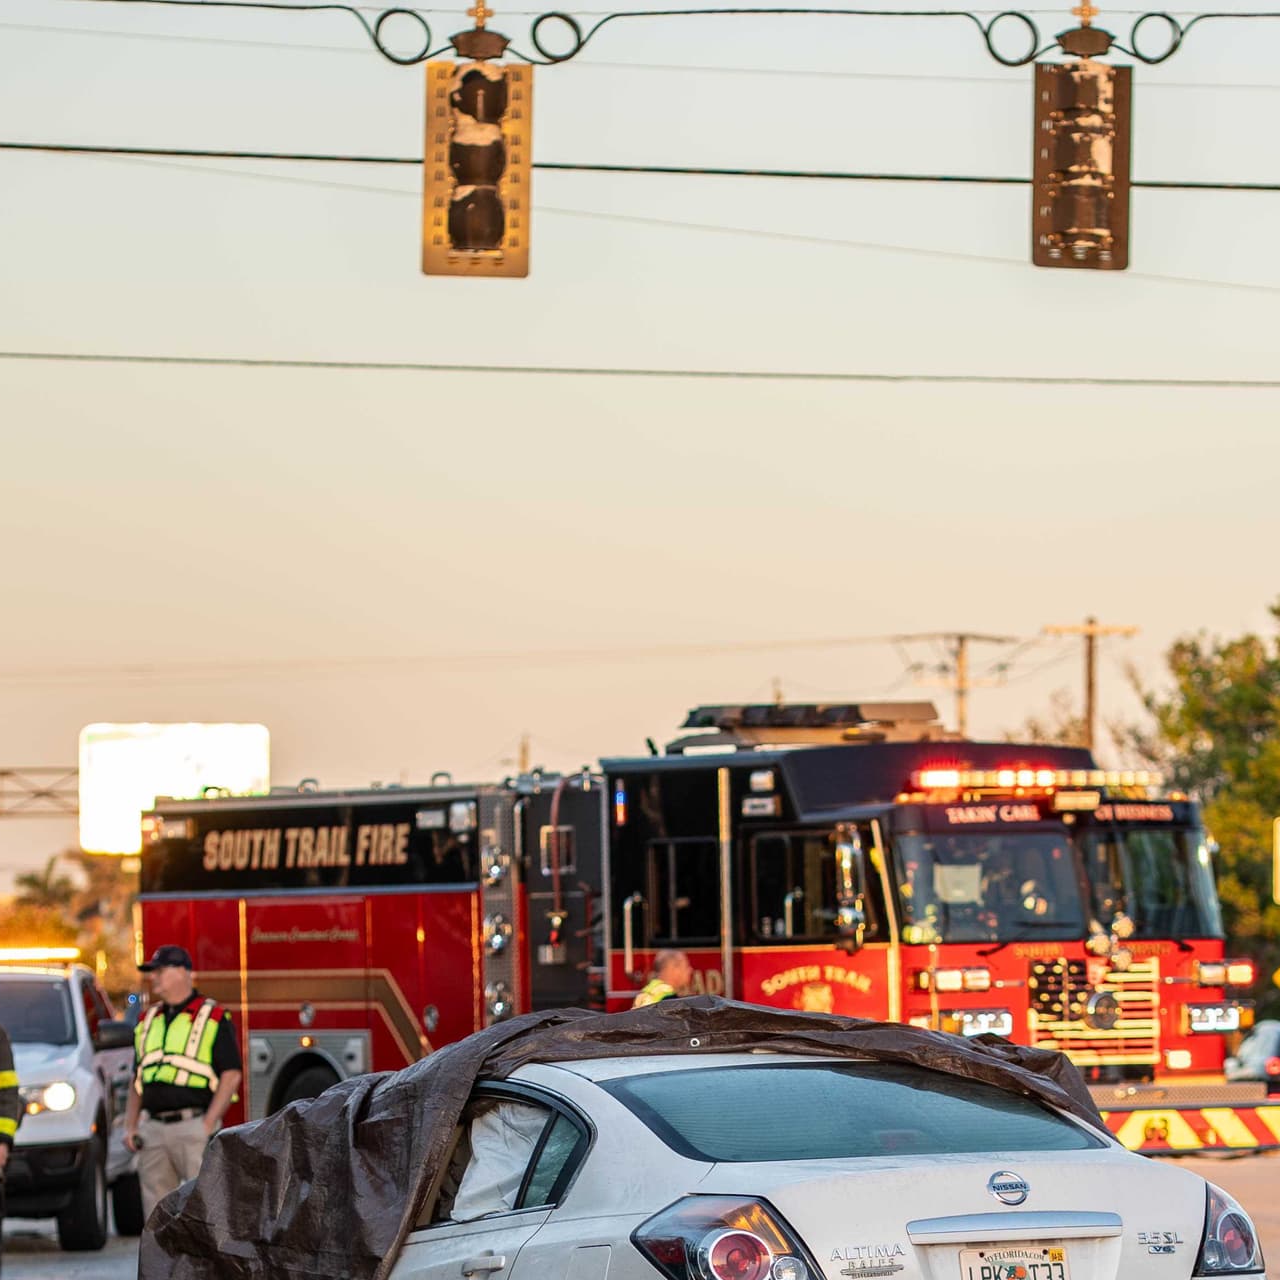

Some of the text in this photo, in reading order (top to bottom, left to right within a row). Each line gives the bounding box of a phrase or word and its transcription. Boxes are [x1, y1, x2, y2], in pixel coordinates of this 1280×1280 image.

[203, 823, 410, 871] SOUTH TRAIL FIRE
[761, 965, 872, 996] SOUTH TRAIL
[992, 1183, 1028, 1192] NISSAN
[830, 1243, 906, 1261] ALTIMA
